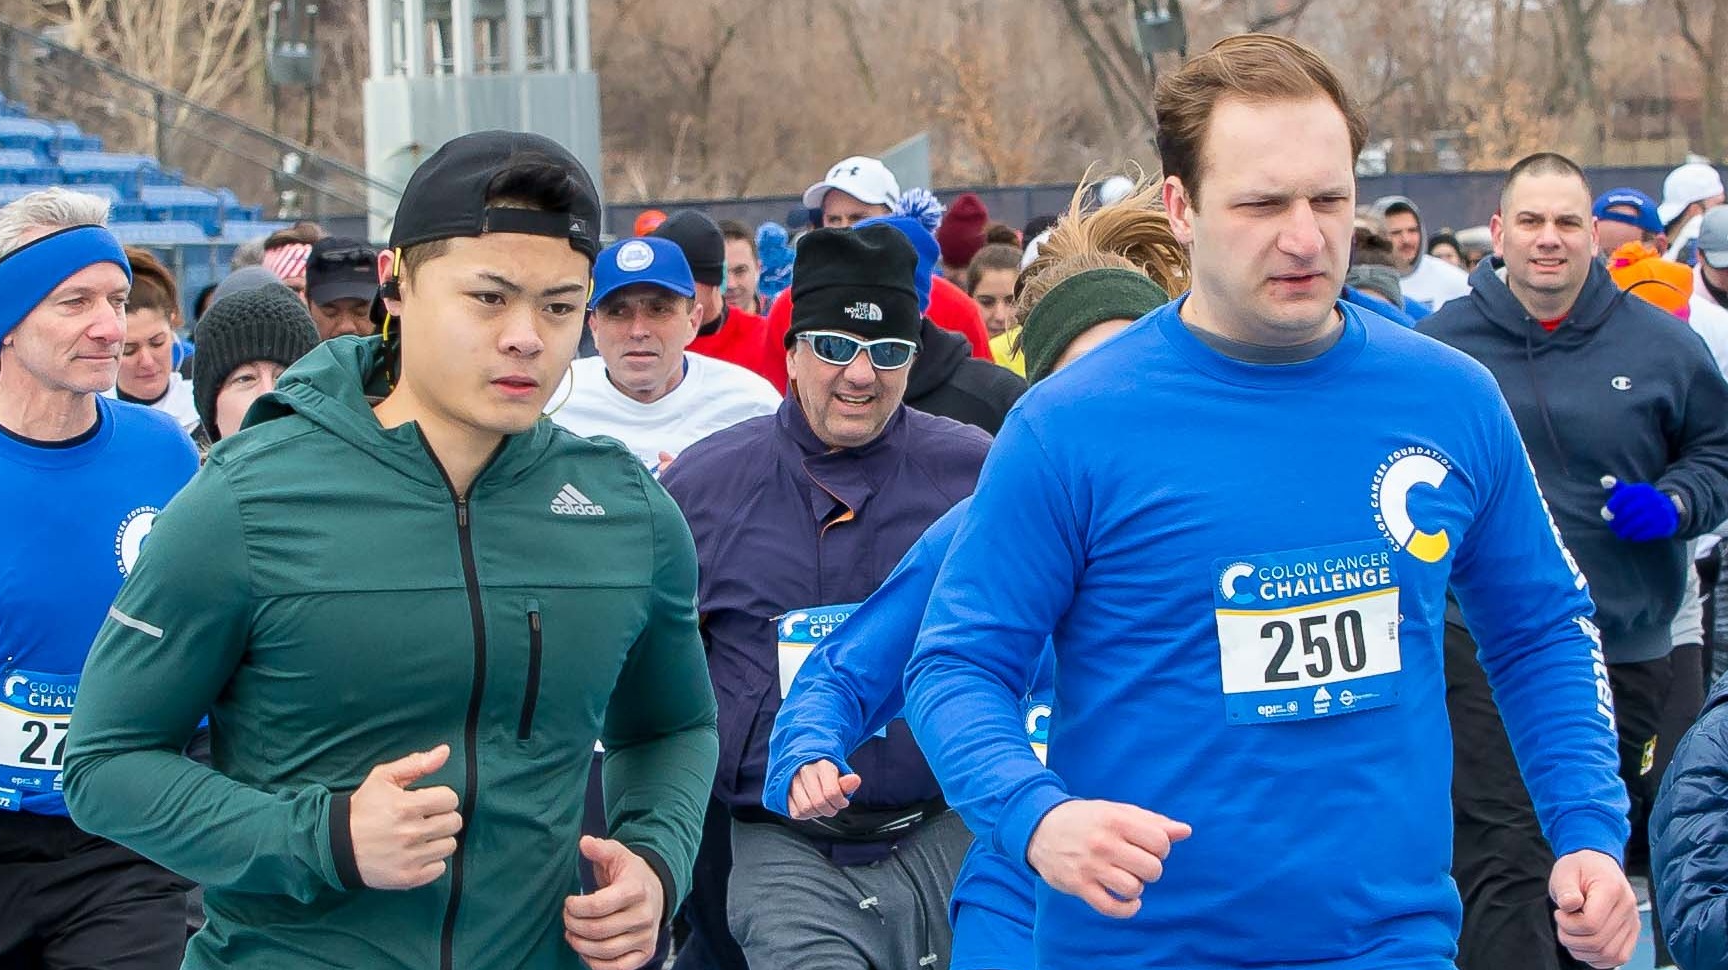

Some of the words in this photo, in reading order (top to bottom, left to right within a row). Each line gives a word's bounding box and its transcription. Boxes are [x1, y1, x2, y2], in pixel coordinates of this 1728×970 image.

[1370, 463, 1388, 508] CANCER
[1387, 446, 1453, 471] FOUNDATION
[550, 502, 606, 516] adidas
[1258, 561, 1319, 581] COLON
[1323, 552, 1390, 573] CANCER
[1259, 567, 1391, 601] CHALLENGE
[1260, 609, 1367, 684] 250
[19, 720, 71, 766] 27
